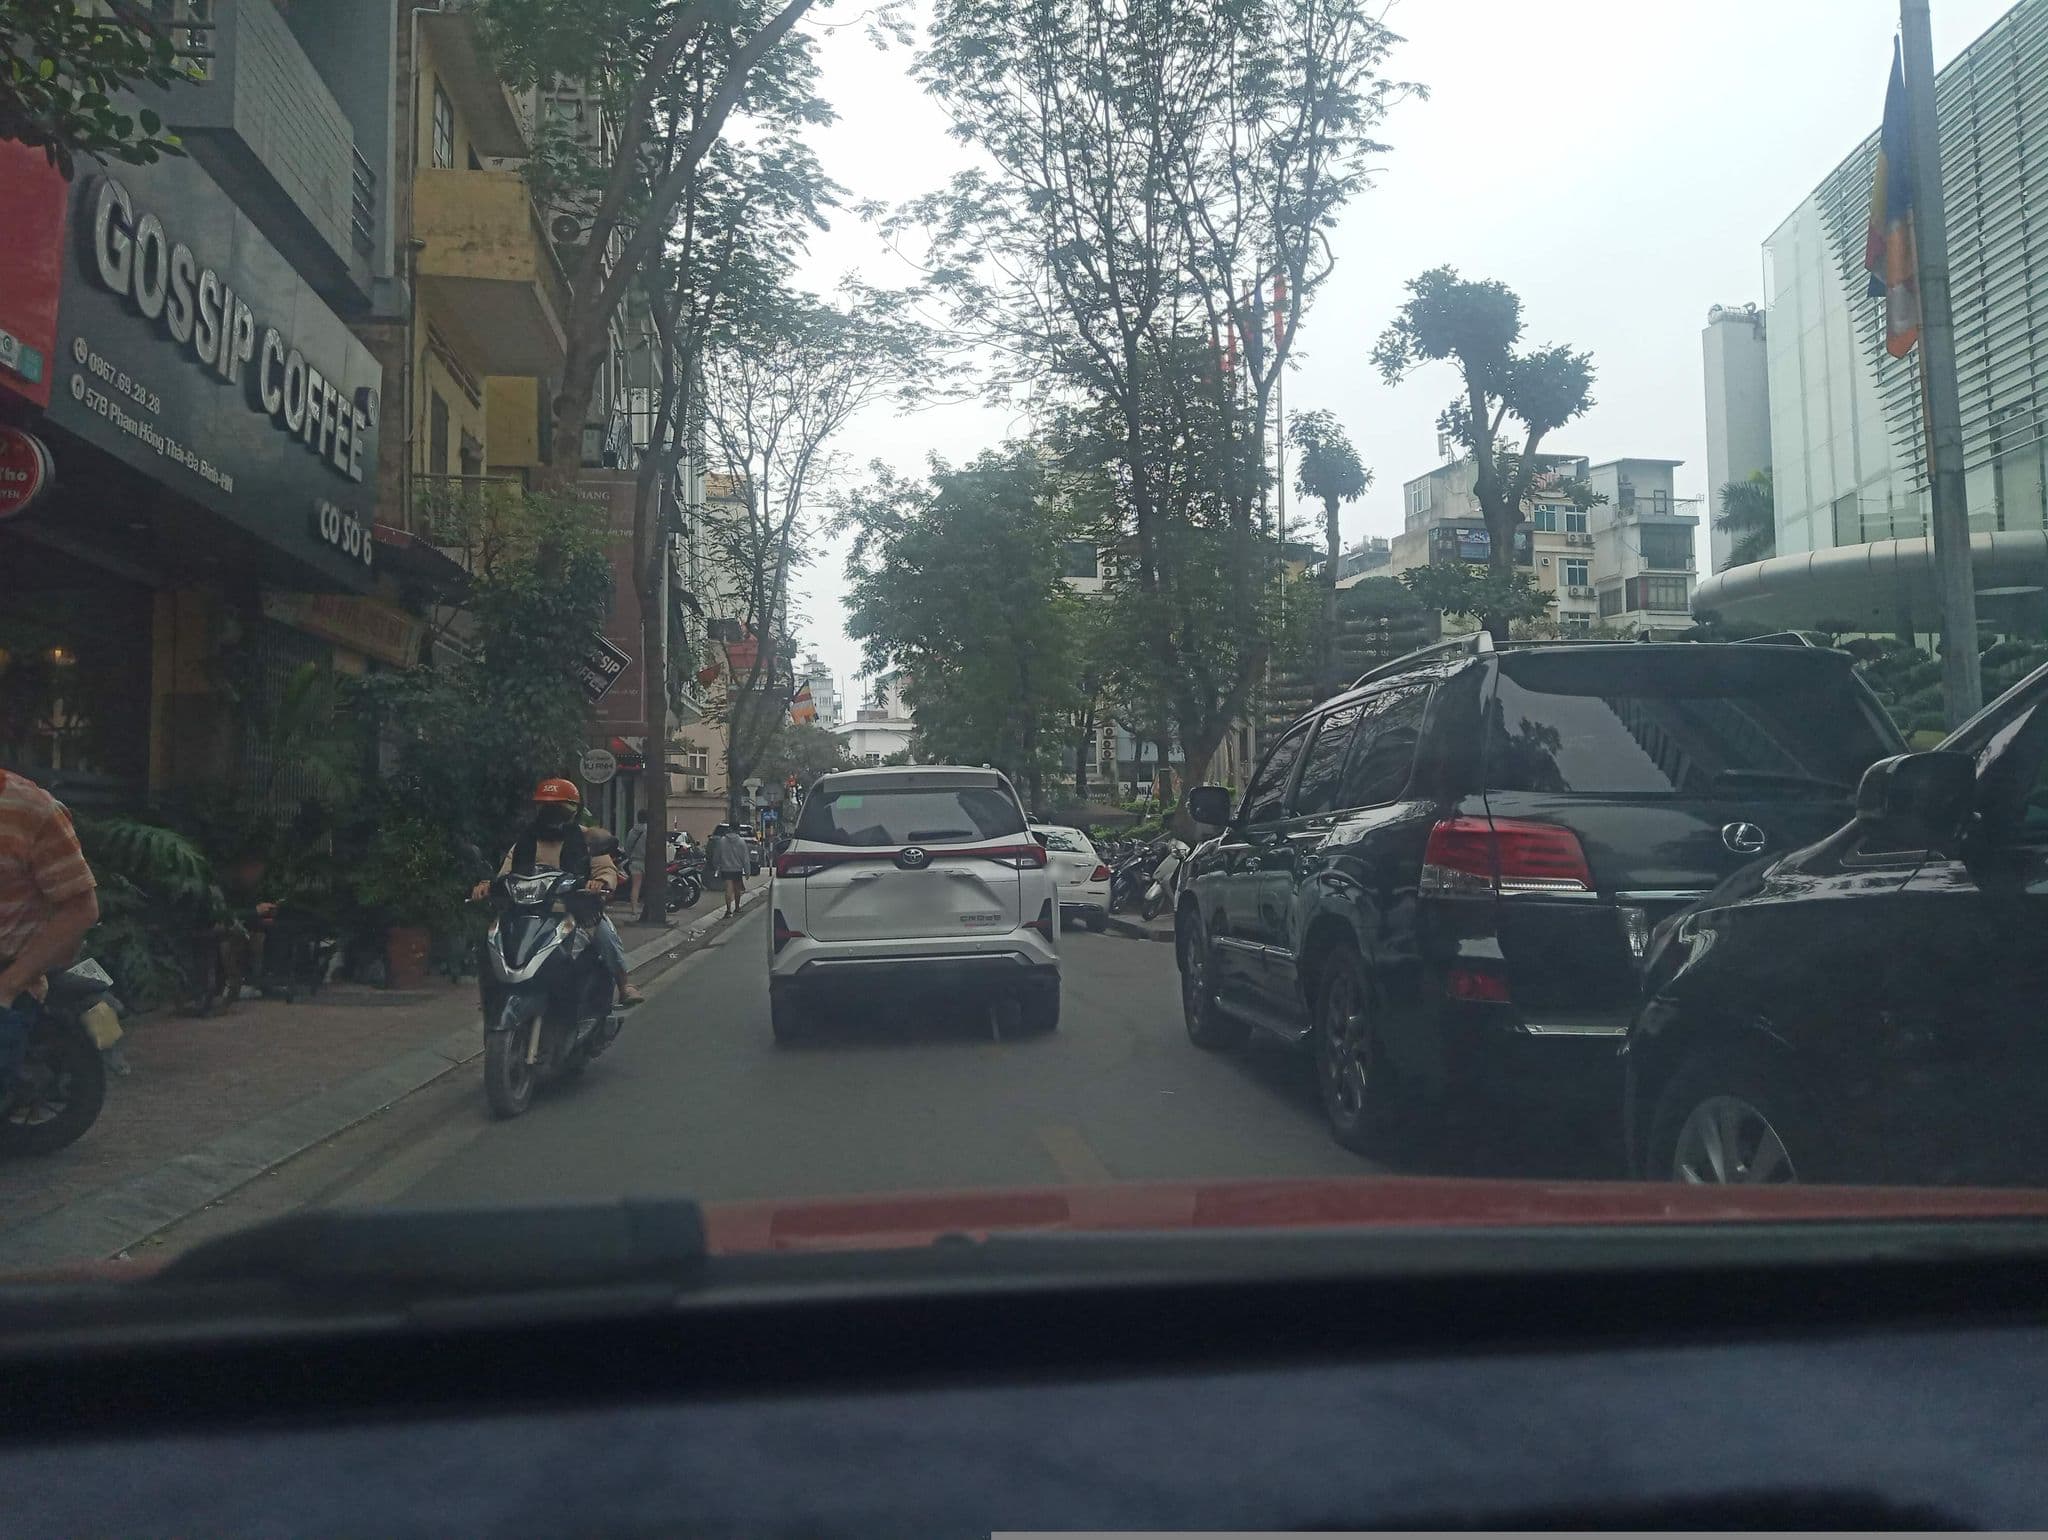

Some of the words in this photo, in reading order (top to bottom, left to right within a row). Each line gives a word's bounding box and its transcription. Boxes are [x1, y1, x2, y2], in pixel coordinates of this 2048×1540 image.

[95, 175, 255, 385] GOSSIP
[260, 328, 366, 483] COFFEE
[86, 387, 108, 416] 57B
[363, 530, 372, 566] 6
